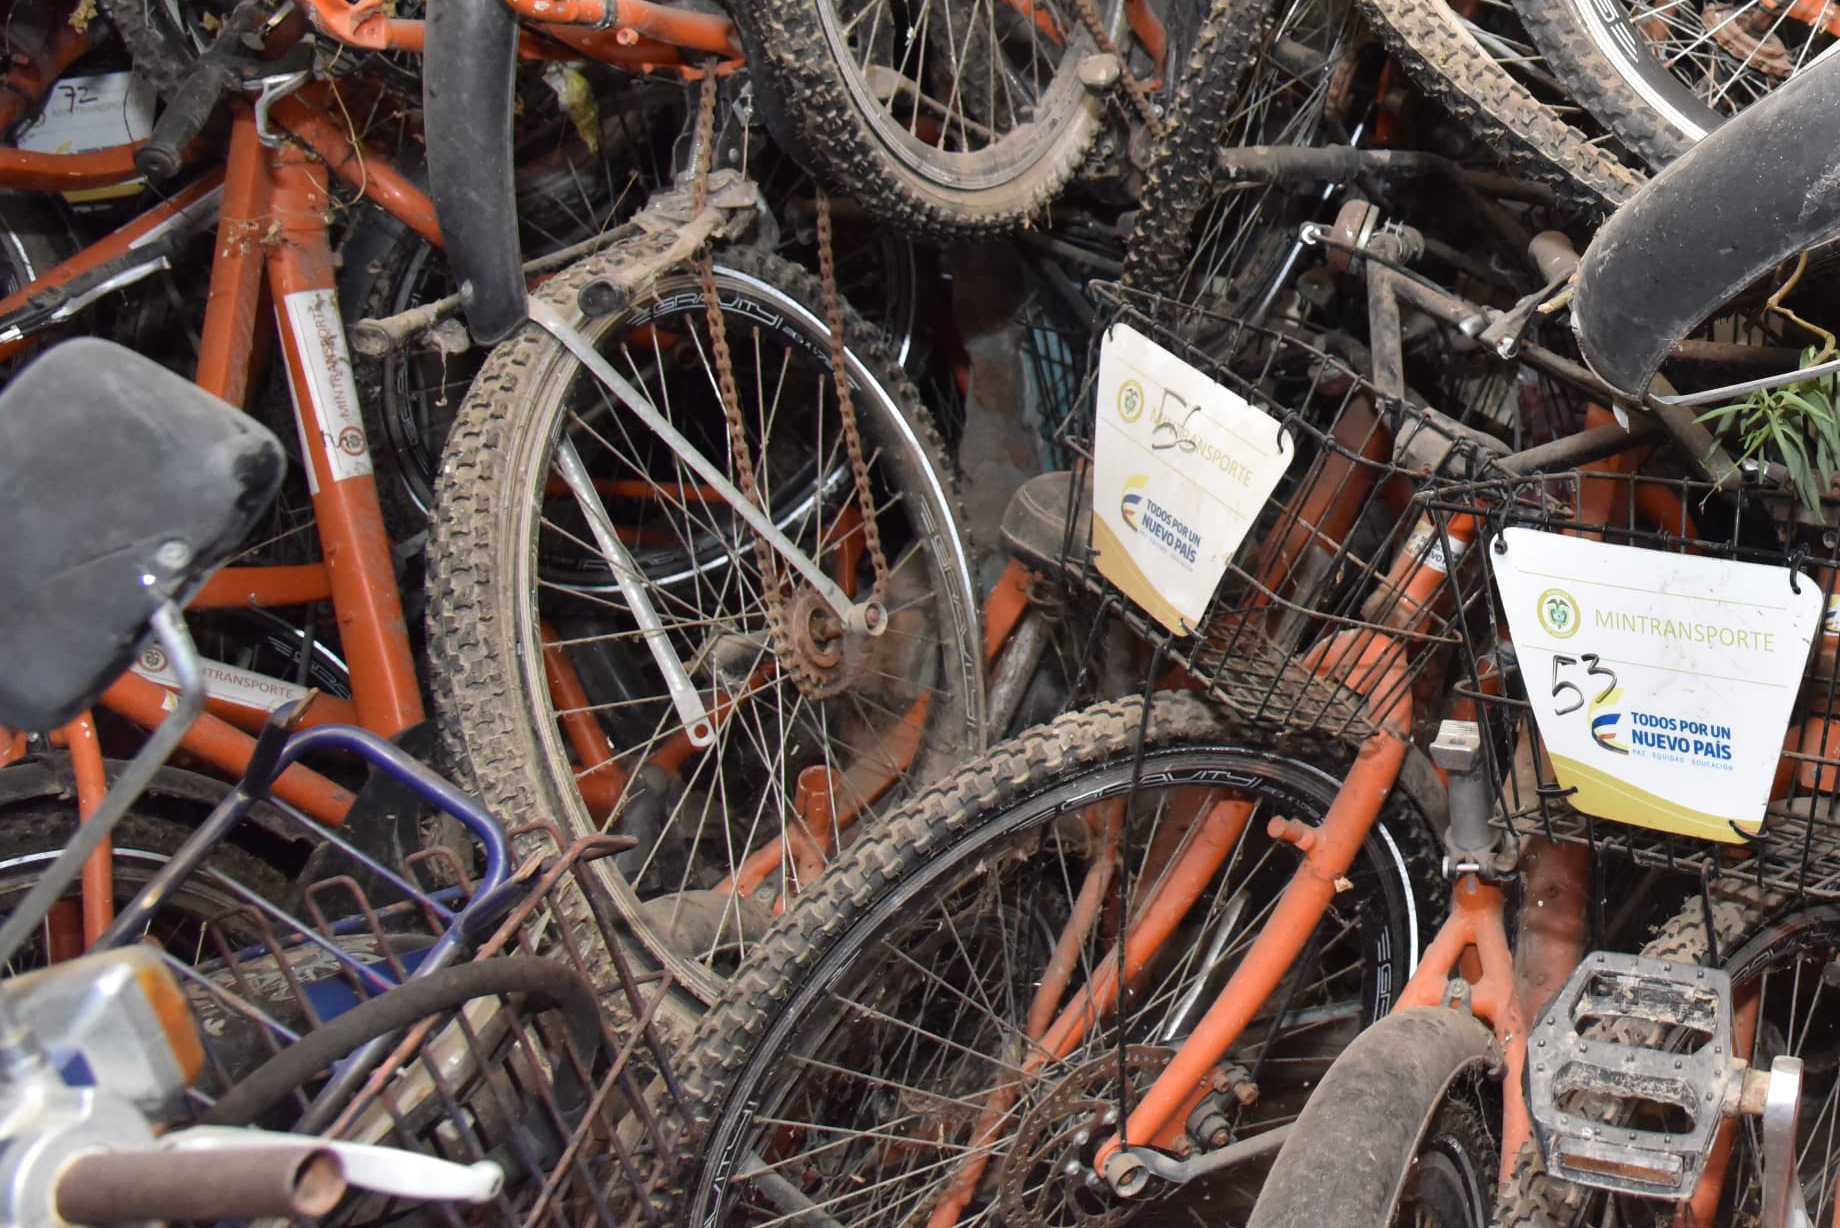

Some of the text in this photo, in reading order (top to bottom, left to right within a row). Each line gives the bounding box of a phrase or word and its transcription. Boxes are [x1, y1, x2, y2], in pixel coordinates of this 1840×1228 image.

[58, 85, 98, 113] 72
[1141, 514, 1174, 550] NUEVO
[1174, 535, 1197, 564] PAÍS
[1147, 498, 1201, 547] TODOS POR UN
[1595, 609, 1776, 653] MINTRANSPORTE
[1552, 653, 1618, 716] 53
[1631, 711, 1732, 740] TODOS POR UN
[1631, 728, 1733, 761] NUEVO PAÍS
